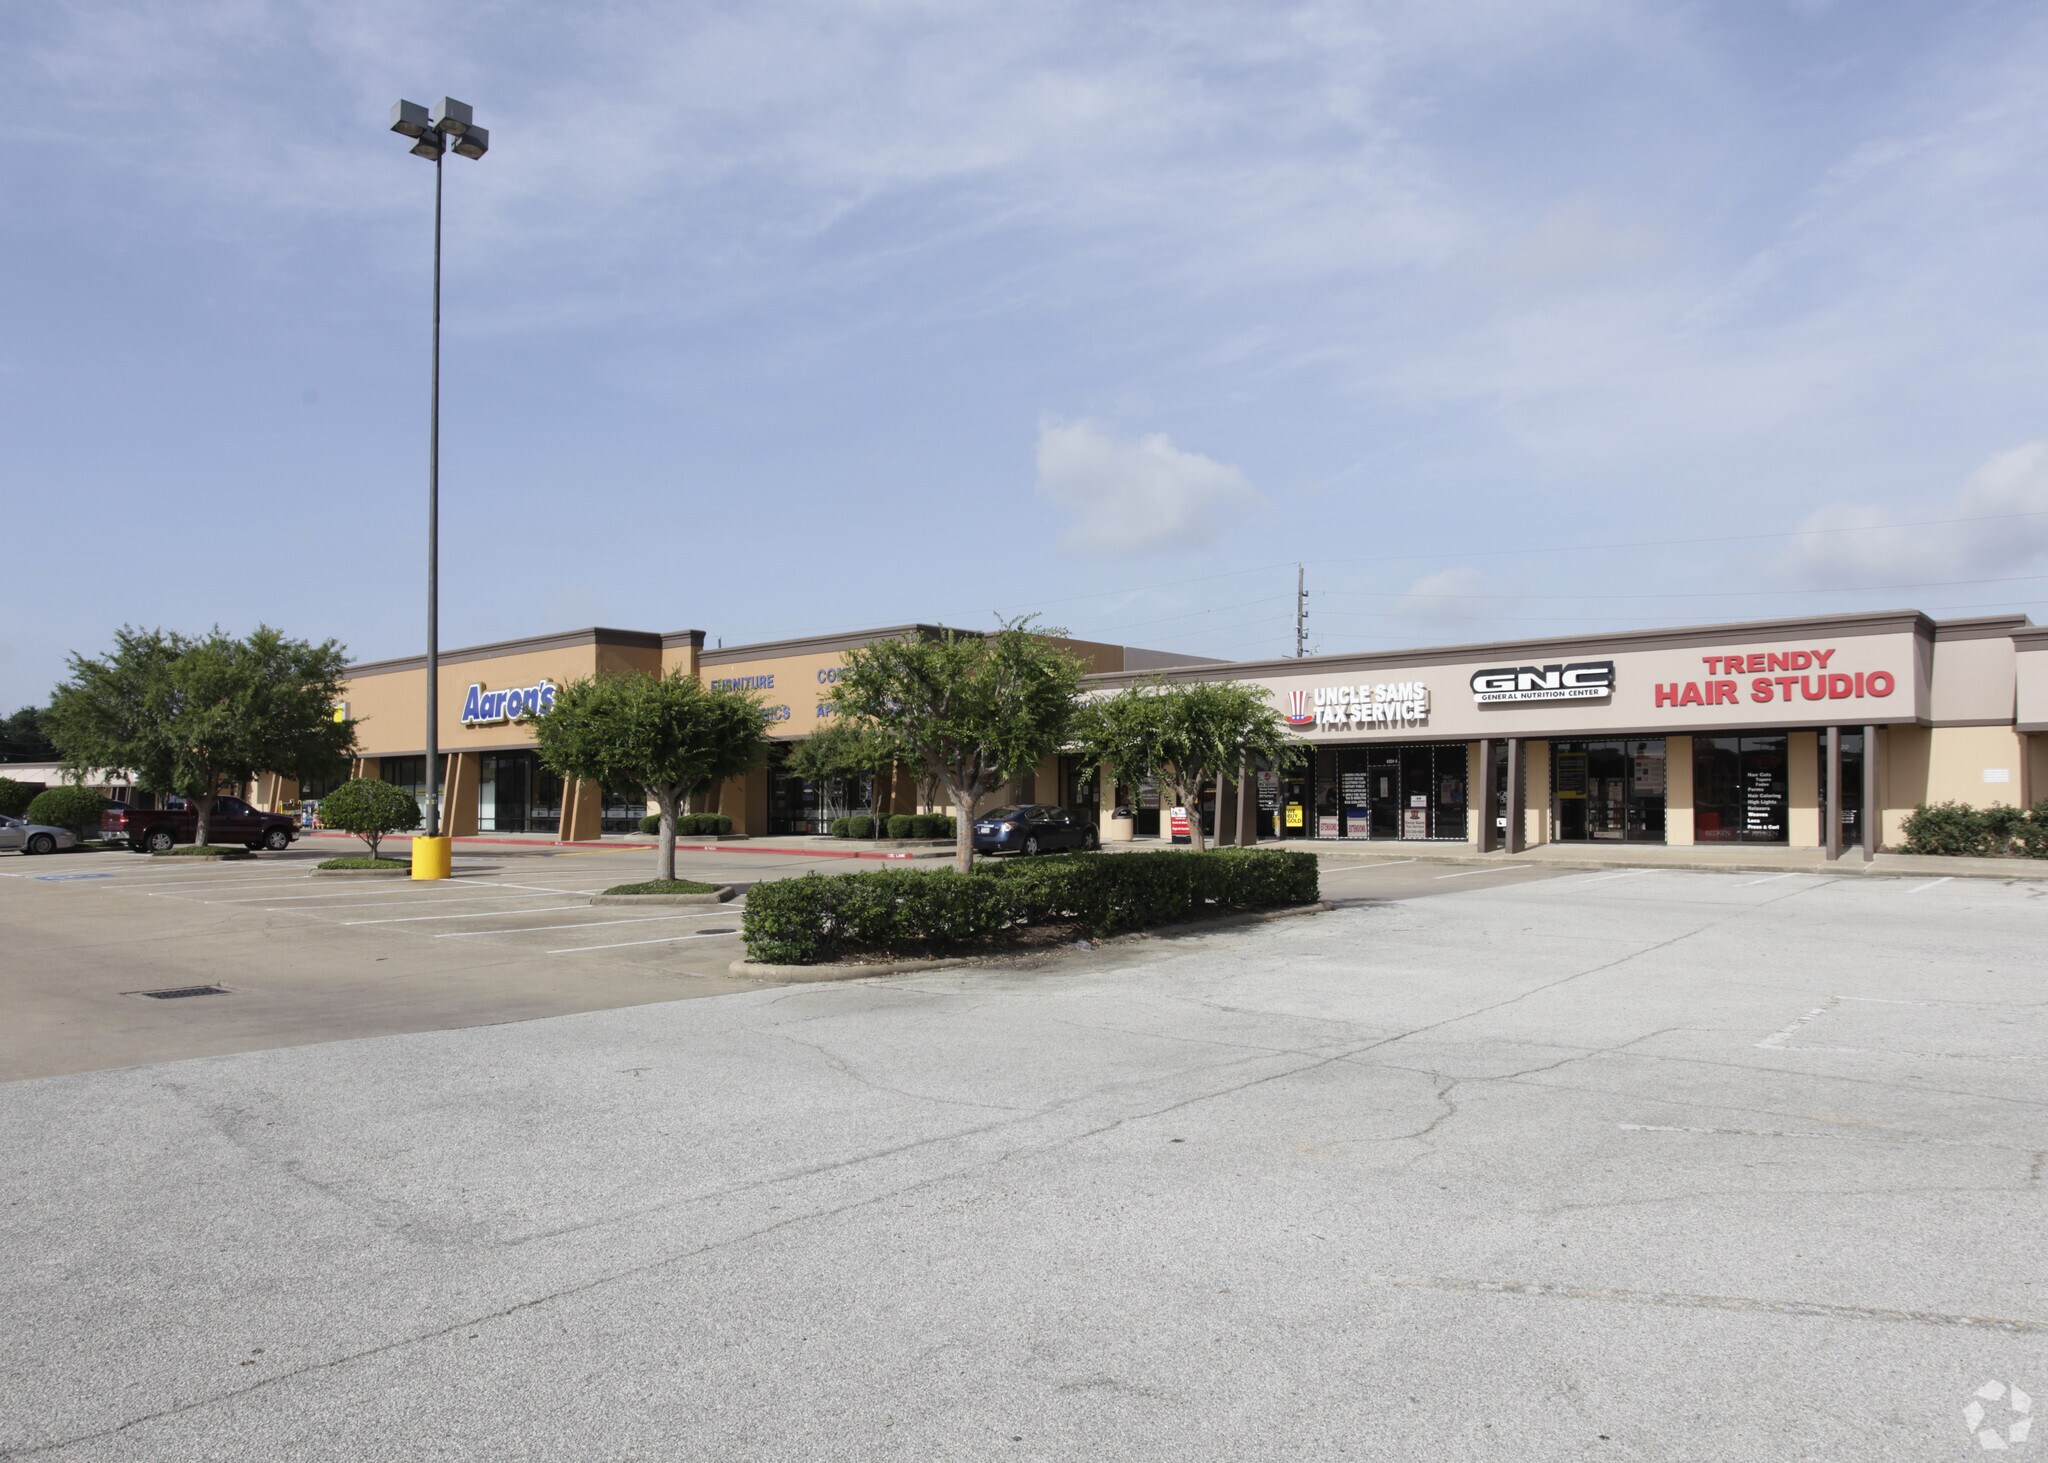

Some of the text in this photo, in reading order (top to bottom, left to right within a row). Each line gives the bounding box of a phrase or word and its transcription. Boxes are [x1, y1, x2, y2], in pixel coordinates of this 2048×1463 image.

[1702, 648, 1836, 675] TRENDY
[1471, 663, 1612, 693] GNC
[1655, 670, 1896, 708] HAIR STUDIO
[461, 679, 557, 724] Aaron's
[1314, 681, 1425, 706] UNCLE SAMS
[1481, 688, 1600, 701] GENERAL NUTRITION CENTER
[1313, 700, 1426, 724] TAX SERVICE
